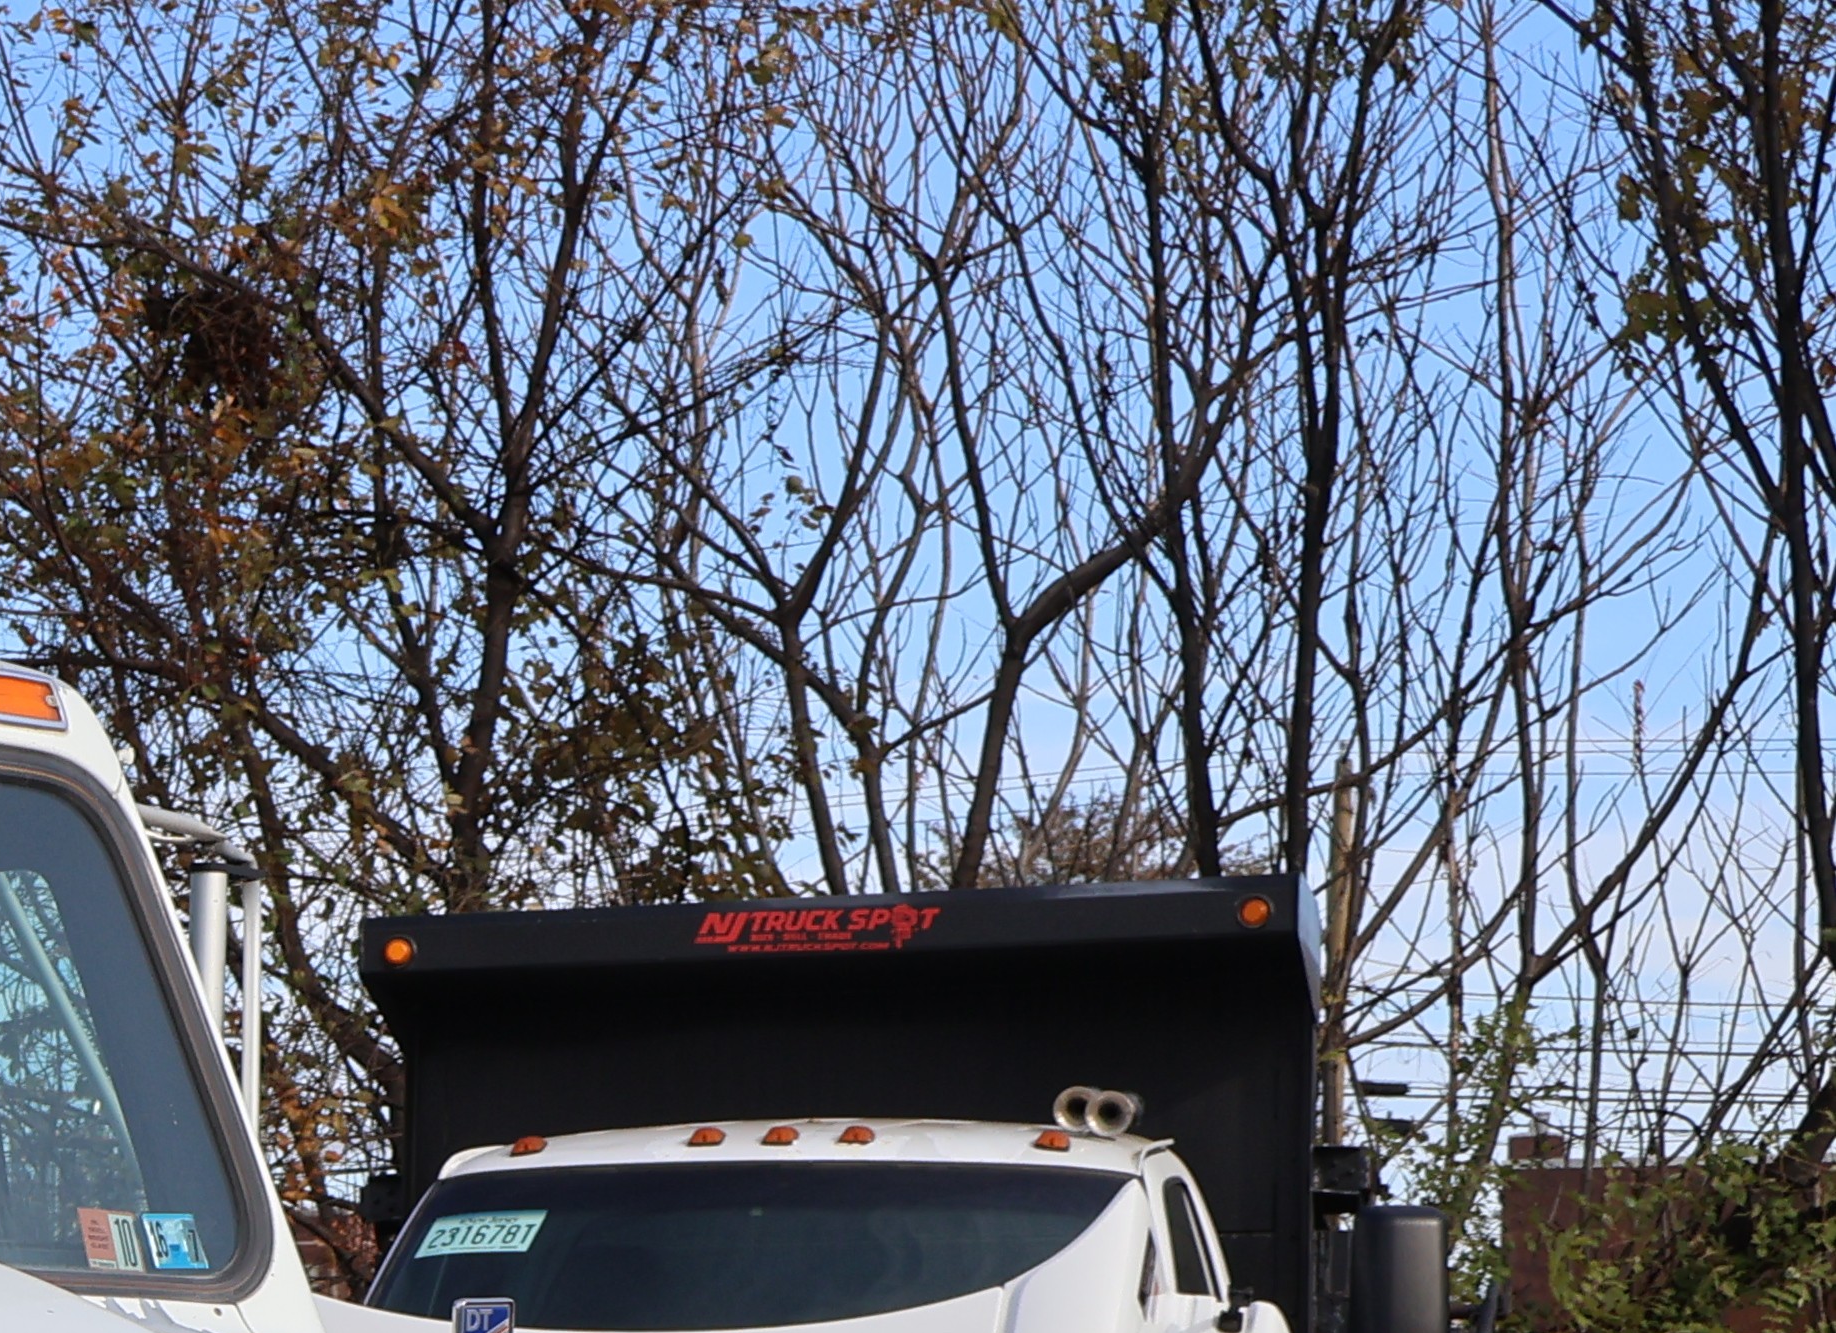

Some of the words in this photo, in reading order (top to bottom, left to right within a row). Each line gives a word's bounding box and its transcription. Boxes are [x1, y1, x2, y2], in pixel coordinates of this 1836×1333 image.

[694, 911, 749, 943] NJ
[749, 910, 844, 932] TRUCK
[113, 1218, 138, 1267] 10
[427, 1223, 537, 1249] 231678T
[465, 1308, 494, 1332] DT
